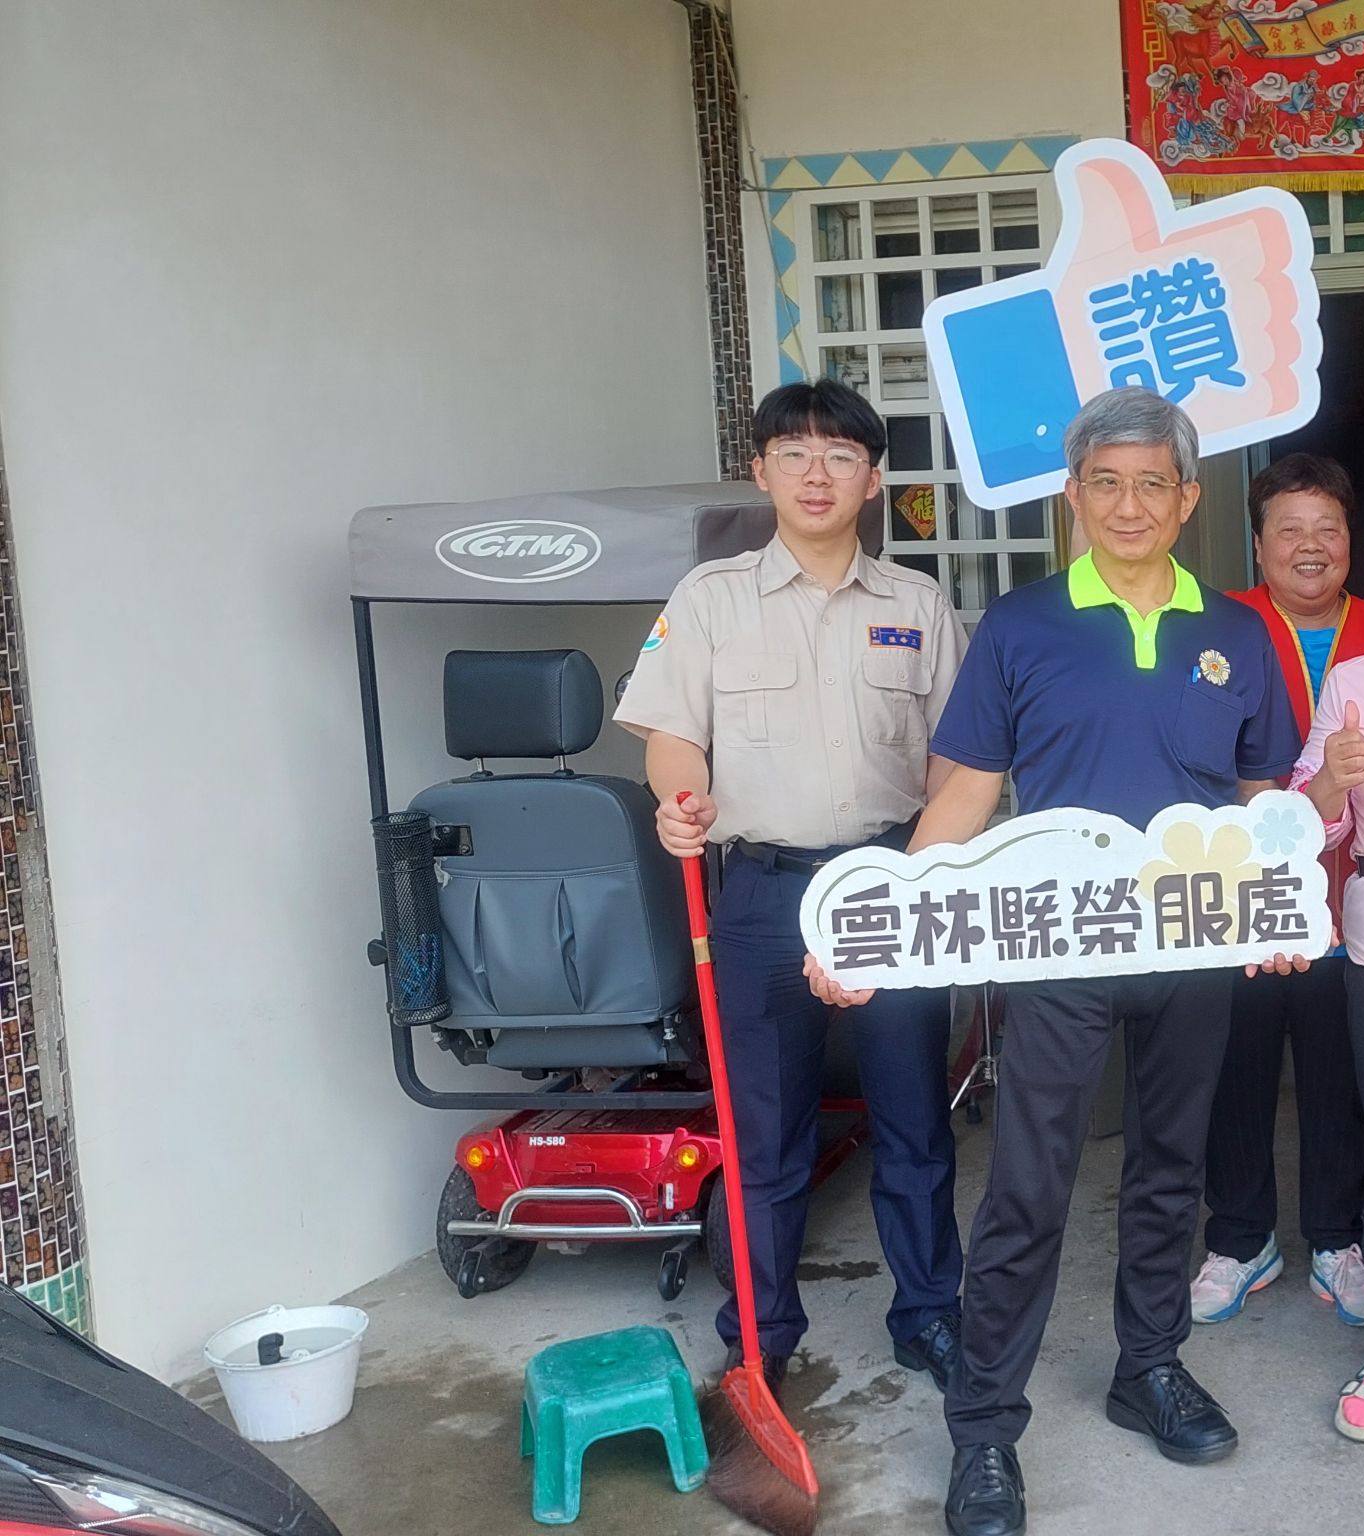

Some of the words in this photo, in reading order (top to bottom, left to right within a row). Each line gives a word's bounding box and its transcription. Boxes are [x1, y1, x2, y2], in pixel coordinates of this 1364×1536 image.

[1089, 257, 1246, 405] 讚
[831, 861, 1309, 971] 雲林縣榮服處
[529, 1136, 566, 1146] HS-580
